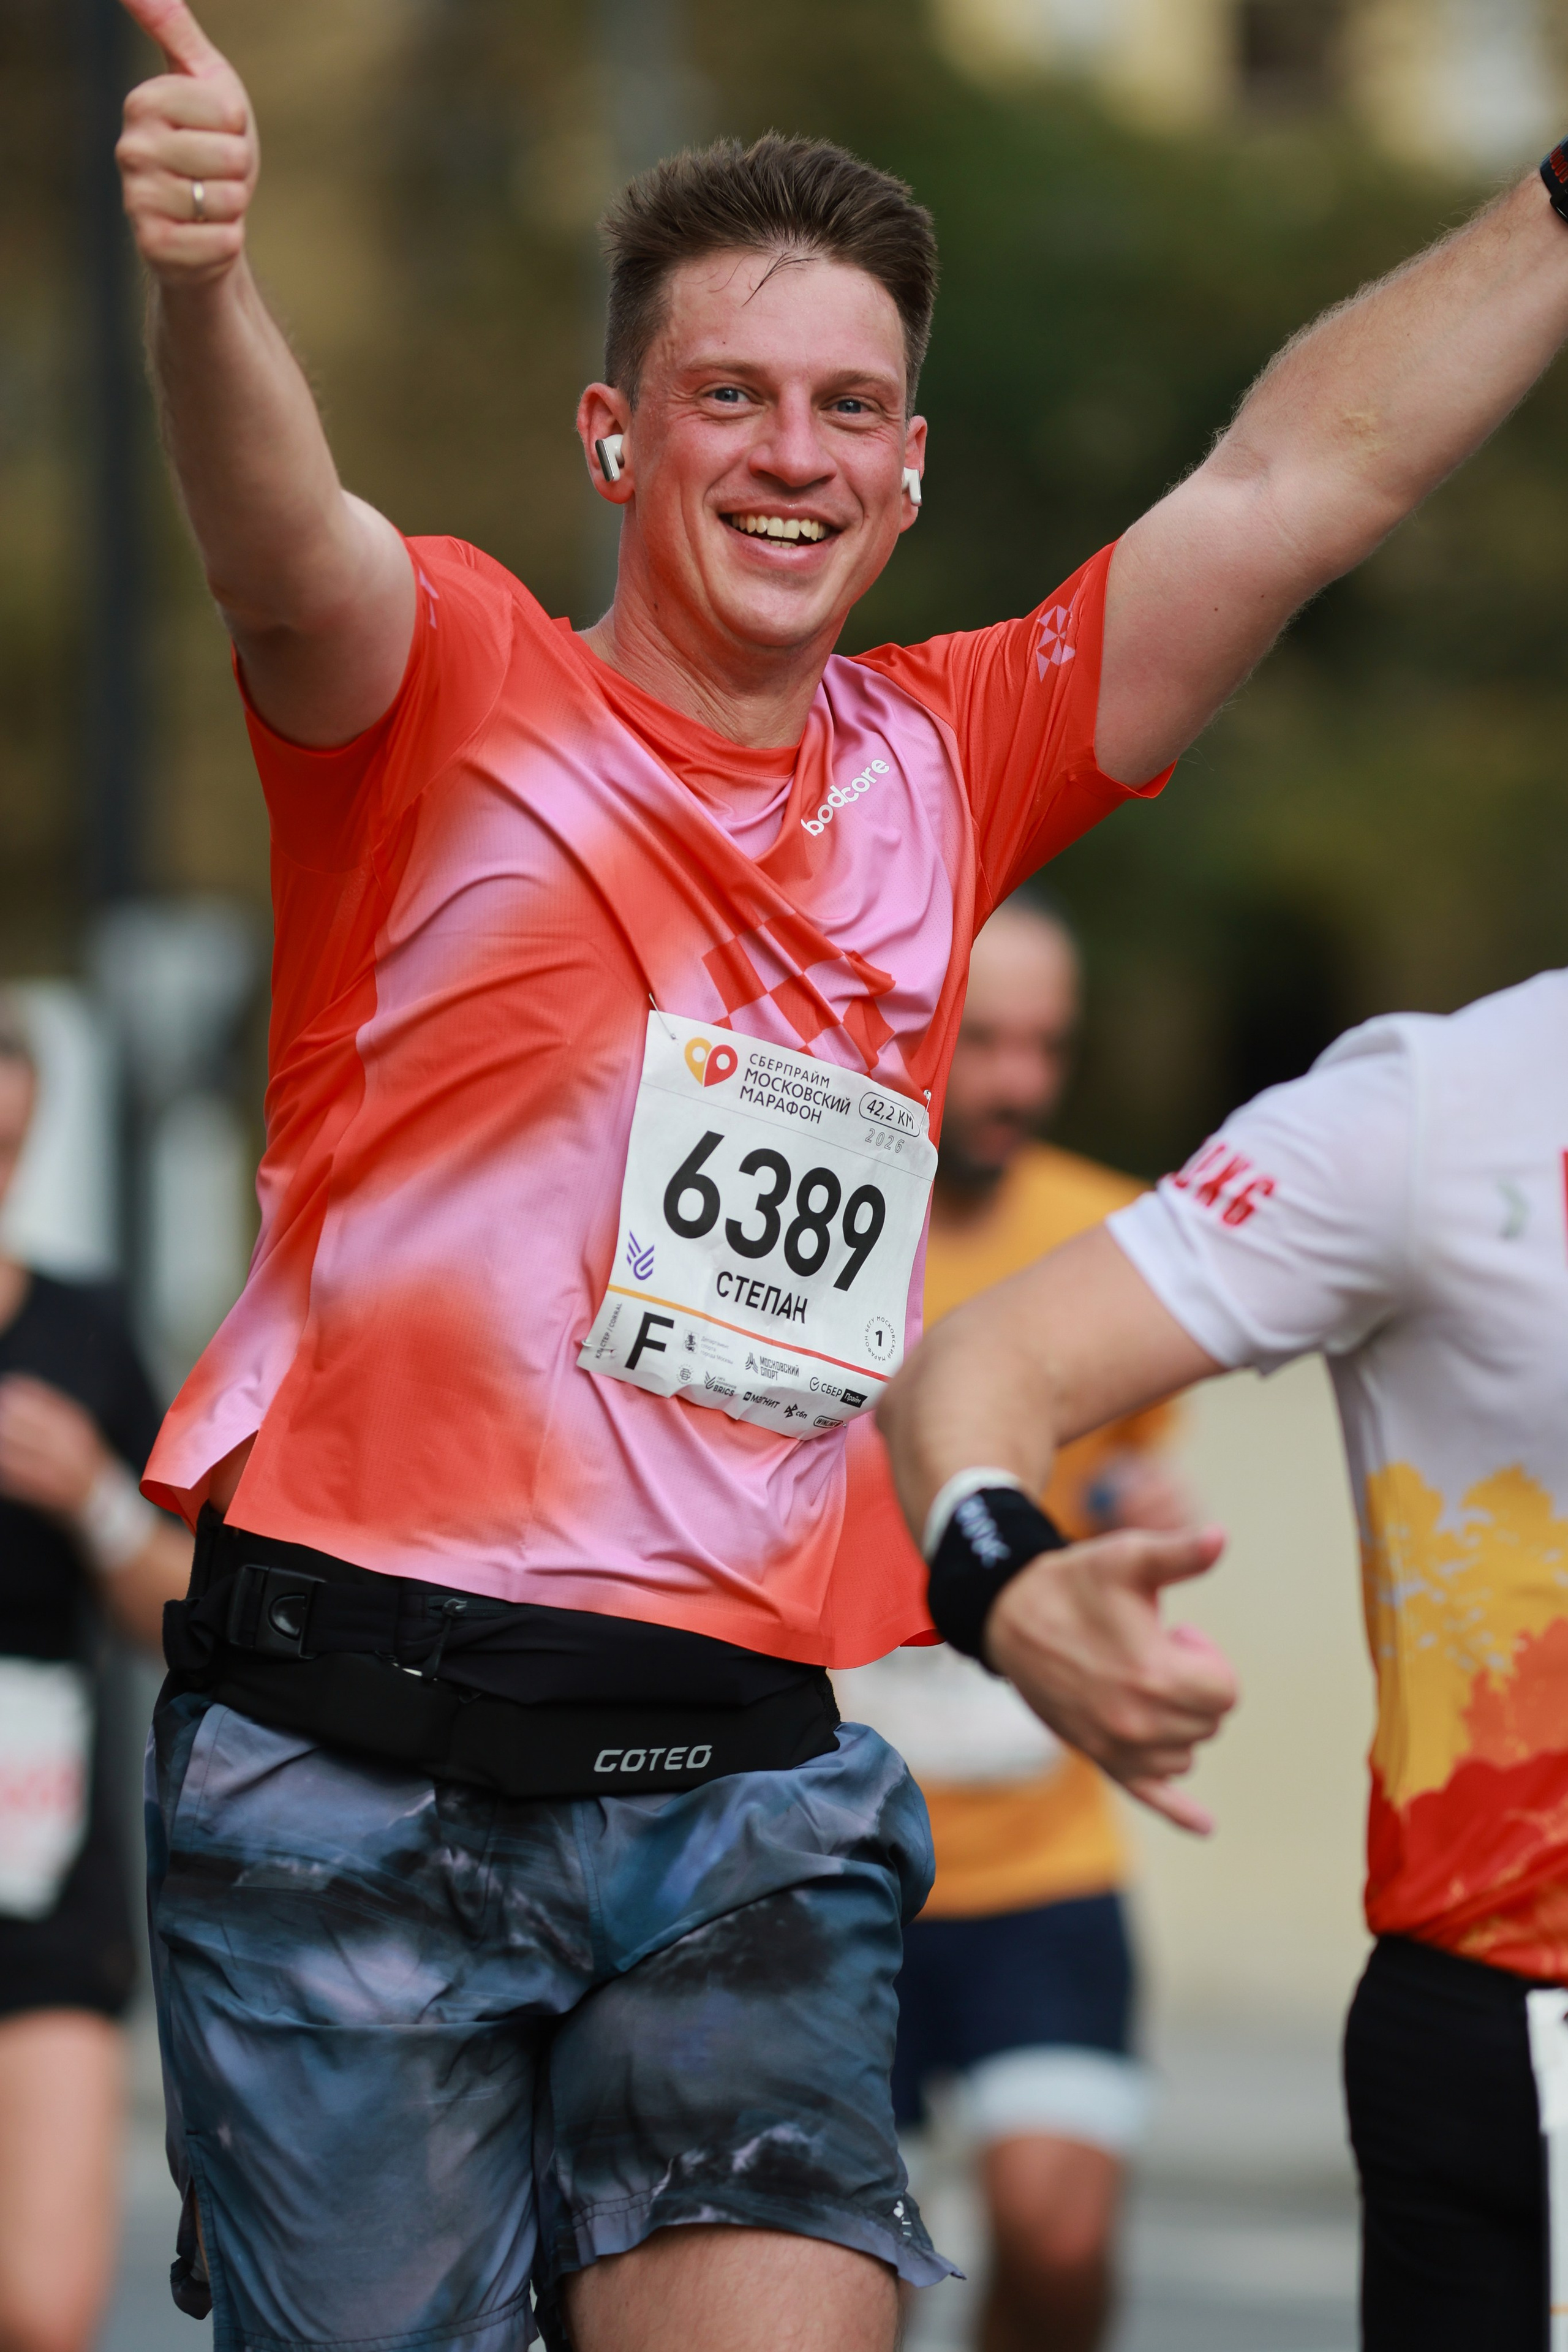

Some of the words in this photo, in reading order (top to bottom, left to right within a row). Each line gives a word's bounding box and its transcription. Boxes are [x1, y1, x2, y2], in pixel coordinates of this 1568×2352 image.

[801, 759, 890, 837] bodcore
[750, 1054, 830, 1088] СБЕРПРАЙМ
[740, 1085, 822, 1124] МАРАФОН
[744, 1068, 851, 1115] МОСКОВСКИЙ
[867, 1099, 895, 1121] 42,2
[897, 1109, 914, 1129] КМ
[865, 1128, 905, 1153] 2026
[663, 1130, 886, 1291] 6389
[717, 1271, 808, 1324] СТЕПАН
[624, 1311, 674, 1370] F
[875, 1330, 883, 1347] 1
[760, 1356, 799, 1377] МОСКОВСКИЙ
[760, 1366, 778, 1381] СПОРТ
[713, 1384, 735, 1396] BRICS
[821, 1383, 843, 1397] СБЕР
[844, 1393, 862, 1404] Прайм
[594, 1745, 712, 1773] GOTEO
